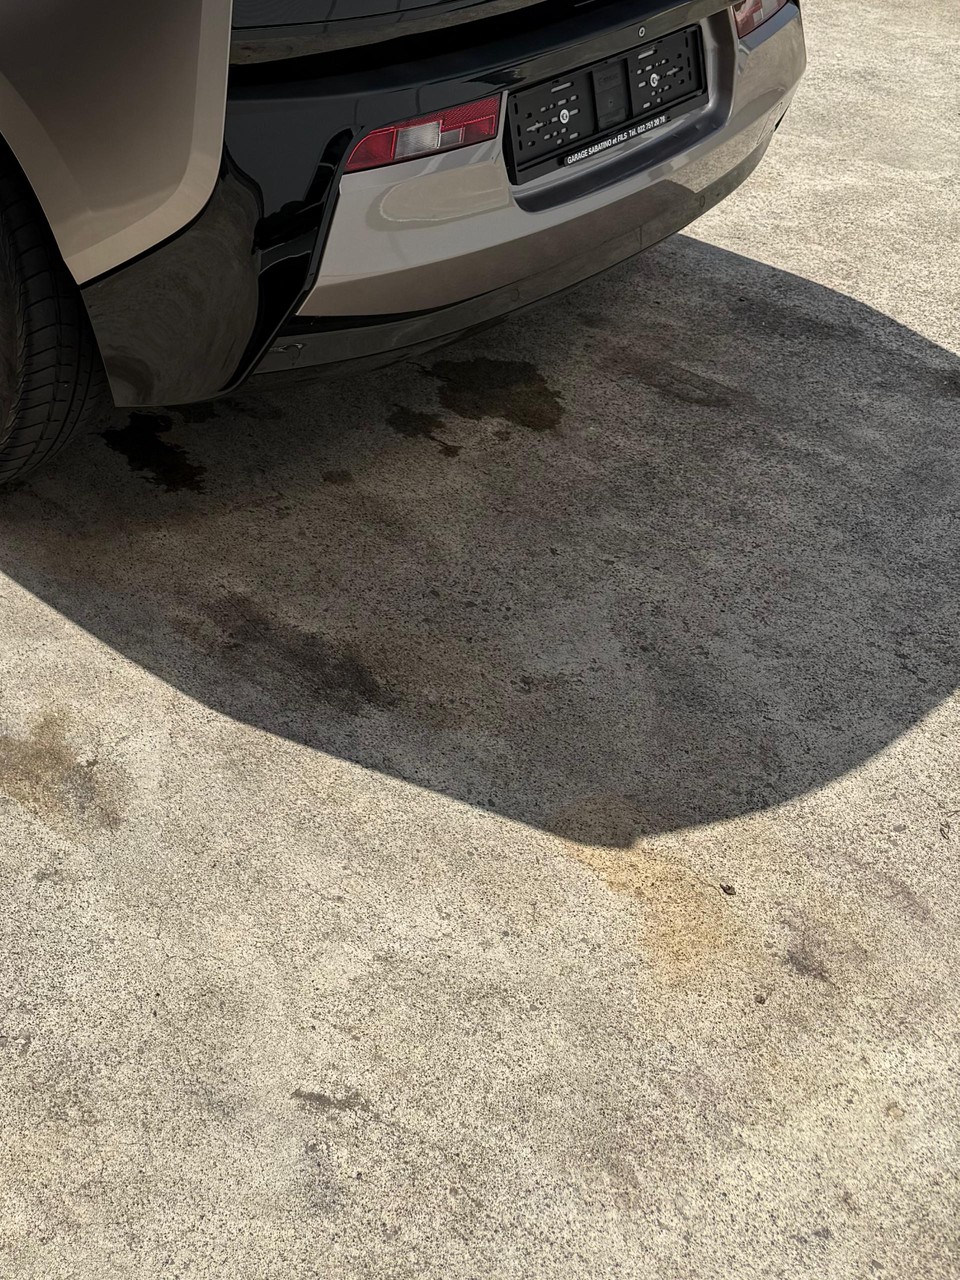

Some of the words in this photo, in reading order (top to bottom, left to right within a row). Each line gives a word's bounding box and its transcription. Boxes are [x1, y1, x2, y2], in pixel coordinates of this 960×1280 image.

[567, 148, 588, 164] GARAGE
[588, 139, 612, 155] SABATINO
[617, 132, 628, 143] FILS
